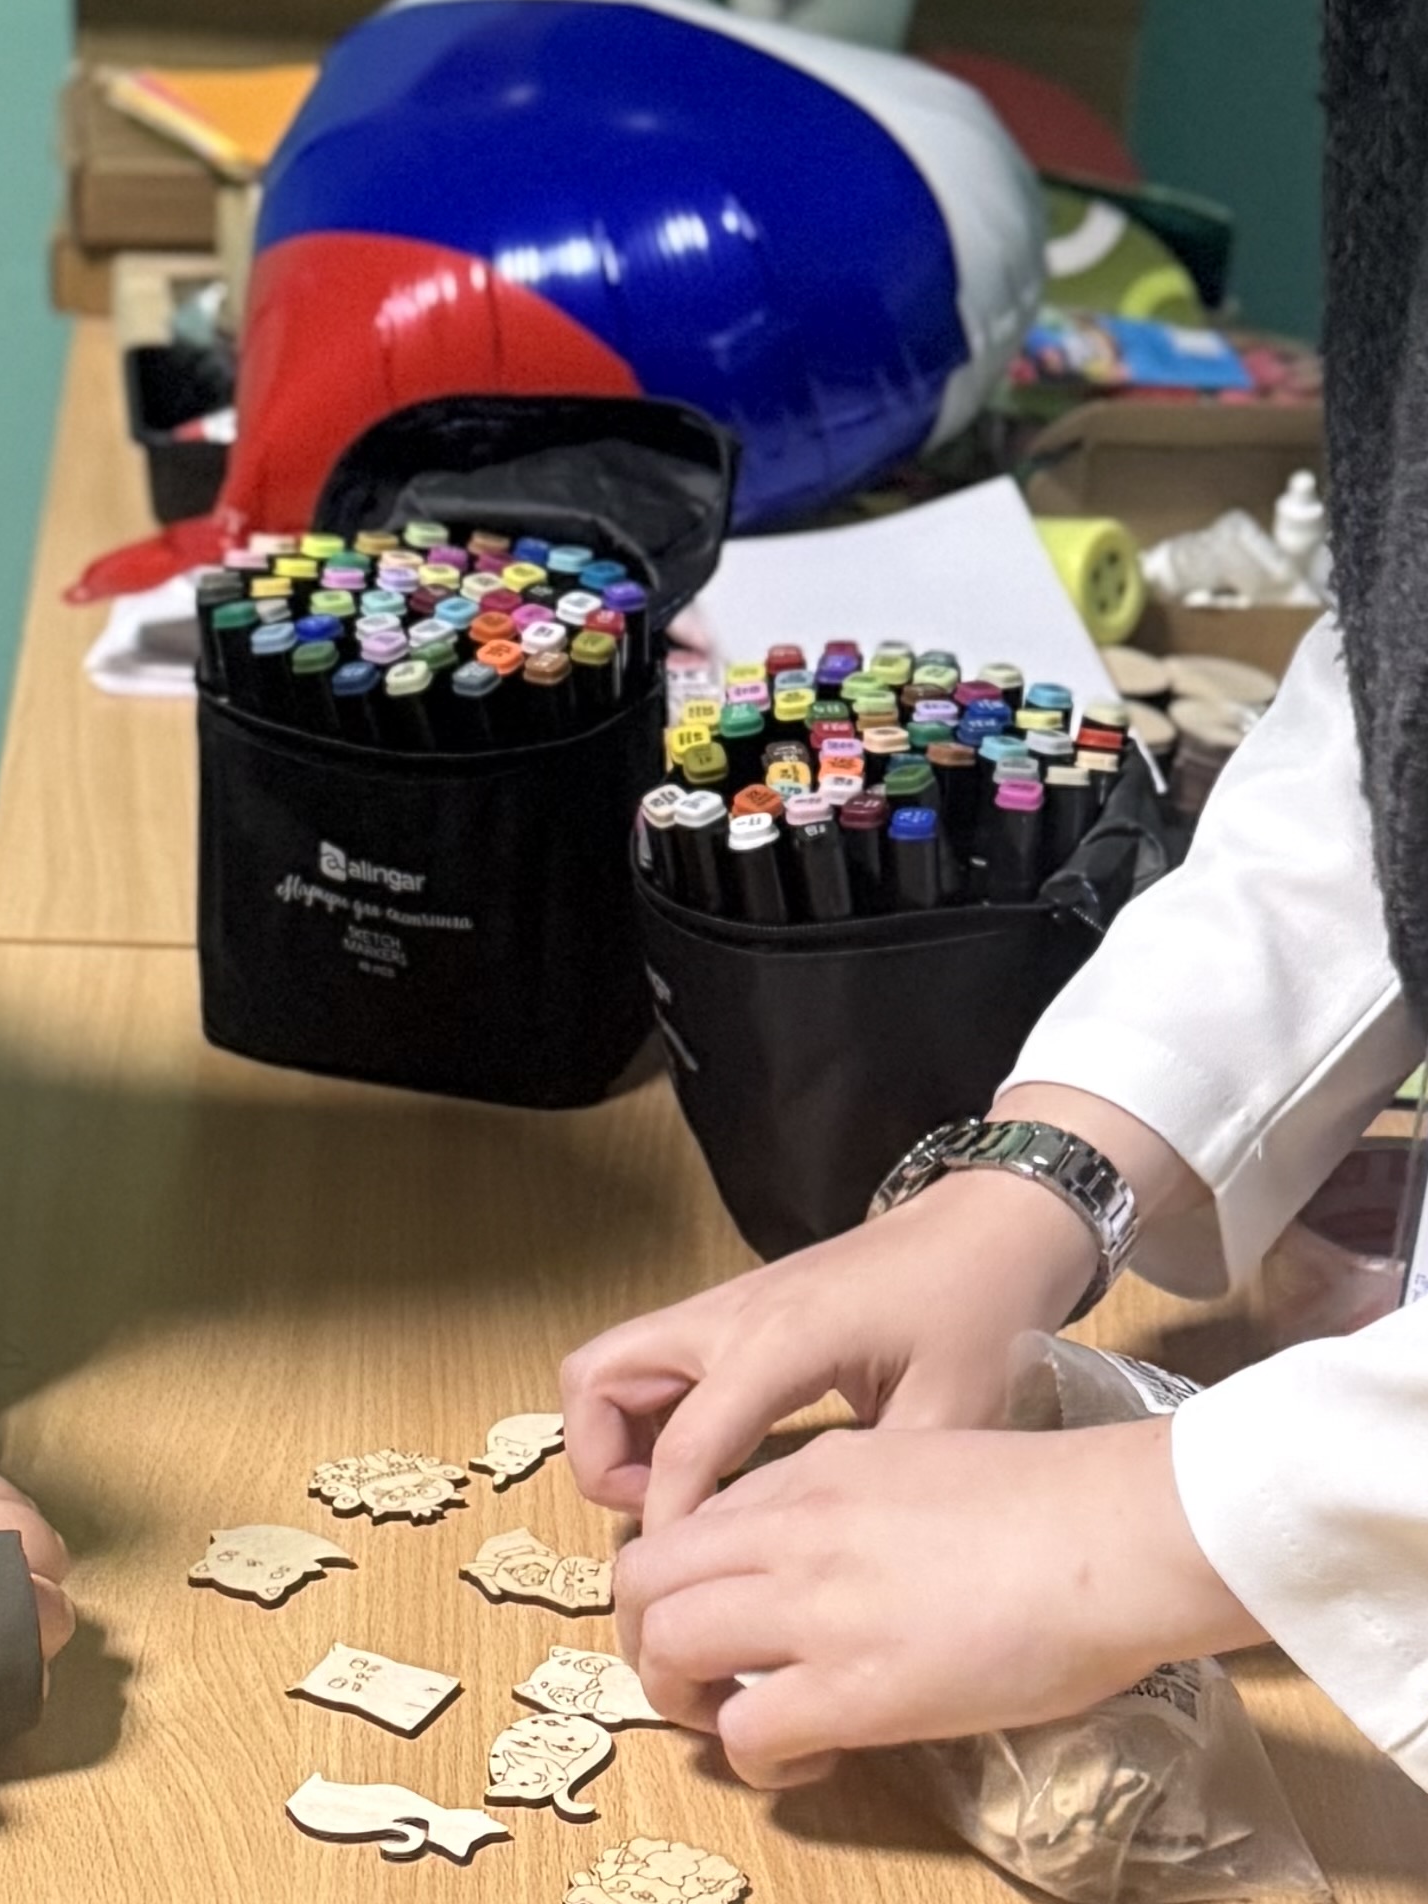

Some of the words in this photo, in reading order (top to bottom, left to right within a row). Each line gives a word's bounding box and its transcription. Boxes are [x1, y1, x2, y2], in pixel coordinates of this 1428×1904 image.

[348, 860, 426, 893] alingar
[343, 937, 408, 967] MARKERS
[348, 925, 401, 950] SKETCH
